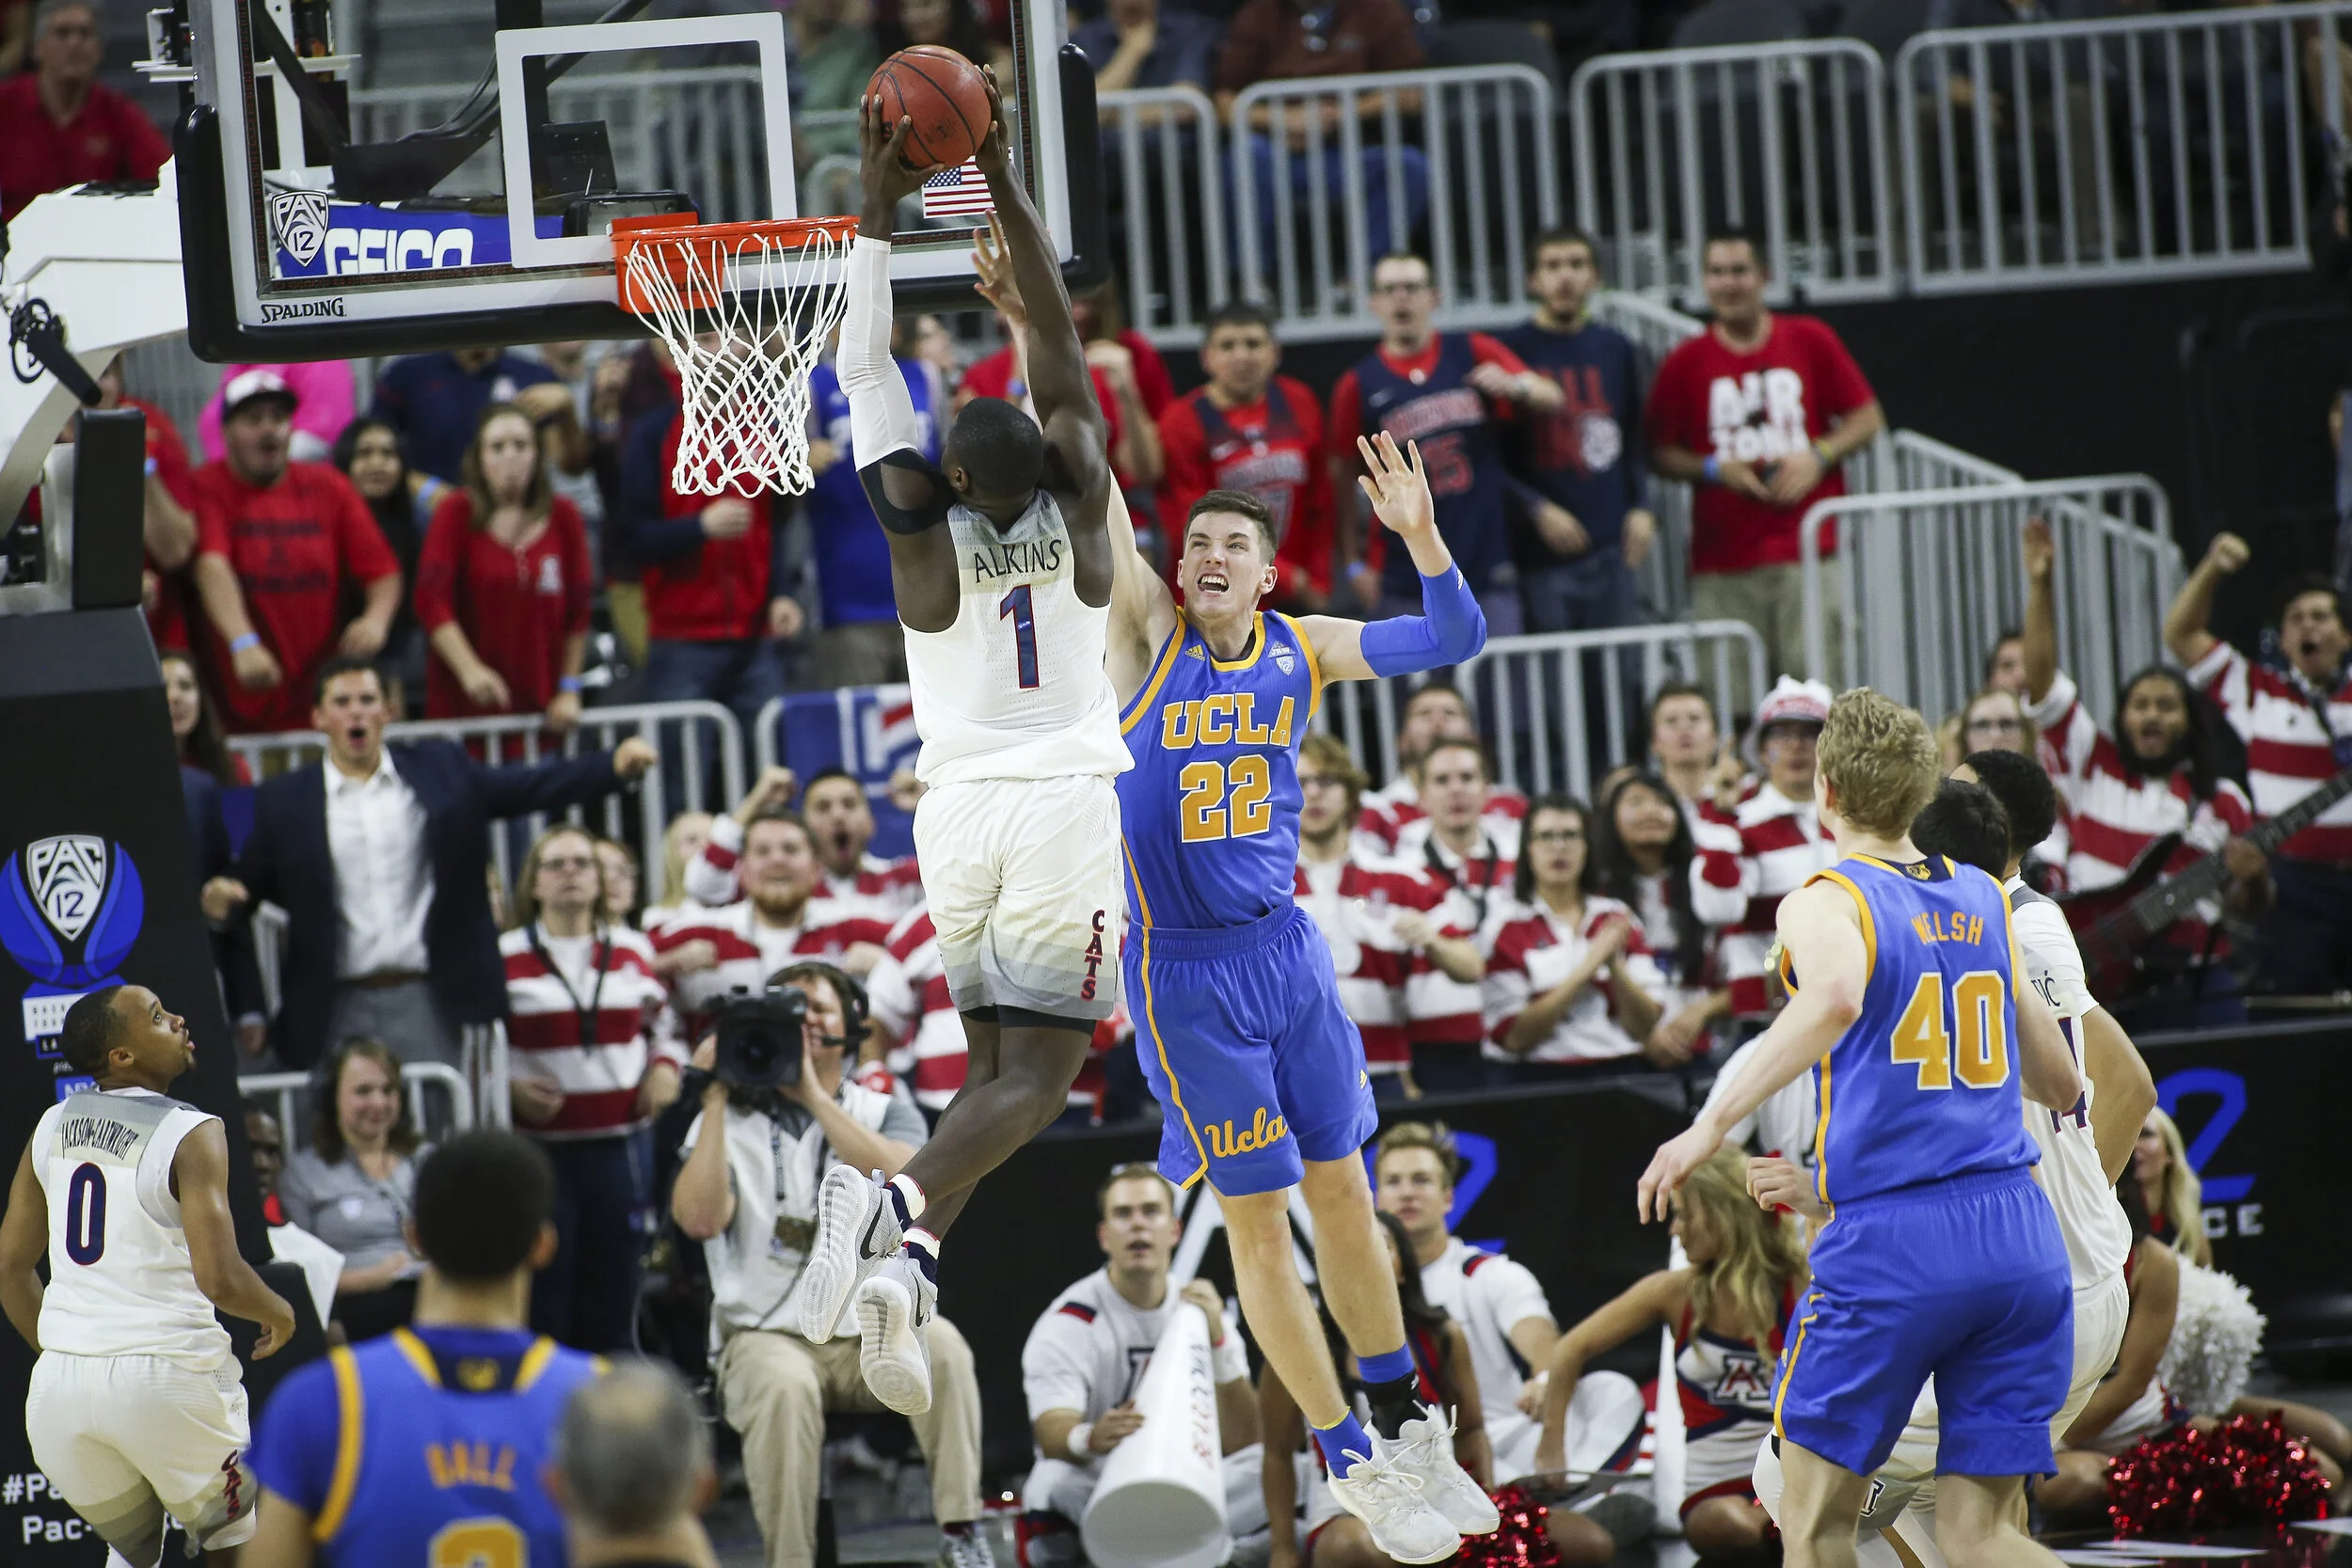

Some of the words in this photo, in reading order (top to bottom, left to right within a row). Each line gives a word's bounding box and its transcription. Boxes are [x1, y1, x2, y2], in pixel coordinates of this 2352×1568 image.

[275, 193, 327, 235] PAC
[293, 230, 315, 252] 12
[324, 228, 473, 276] GEICO
[261, 297, 345, 324] SPALDING
[973, 538, 1062, 583] ALKINS
[999, 583, 1040, 689] 1
[1161, 691, 1295, 750] UCLA
[1179, 753, 1272, 843] 22
[30, 838, 103, 898] PAC
[56, 891, 85, 919] 12
[1911, 911, 1984, 946] WELSH
[1080, 909, 1105, 1002] CATS
[1890, 969, 2010, 1091] 40
[1204, 1106, 1289, 1158] Ucla
[66, 1162, 107, 1266] 0
[425, 1437, 518, 1492] BALL
